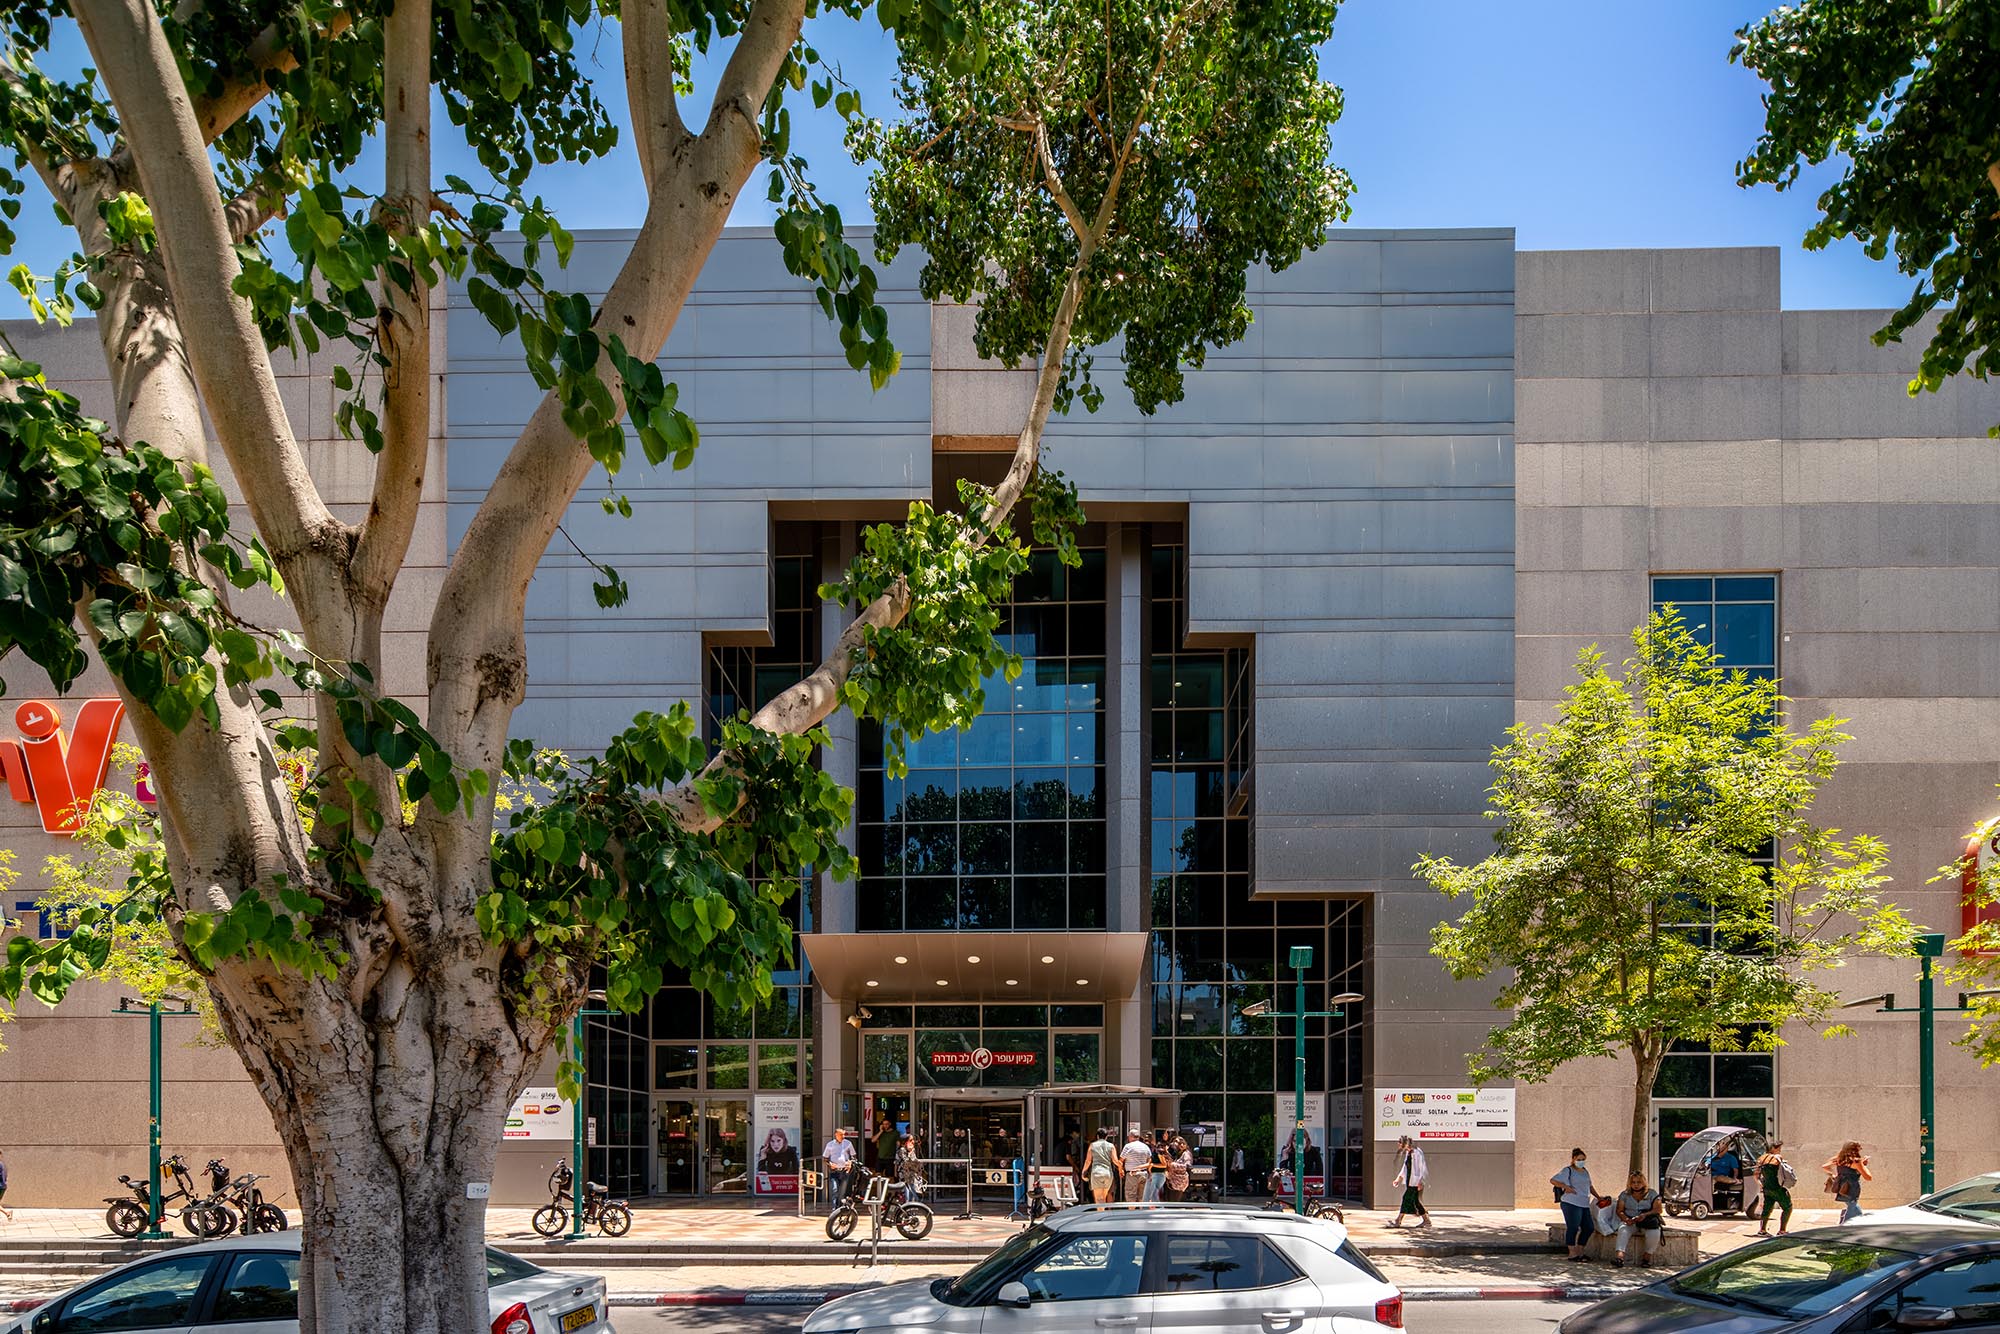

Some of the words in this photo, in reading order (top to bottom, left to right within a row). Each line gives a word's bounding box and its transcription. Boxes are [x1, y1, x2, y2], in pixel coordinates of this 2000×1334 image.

[934, 1054, 957, 1063] חדרה
[958, 1053, 970, 1063] לב
[994, 1054, 1014, 1063] עופר
[1015, 1054, 1033, 1064] קניון
